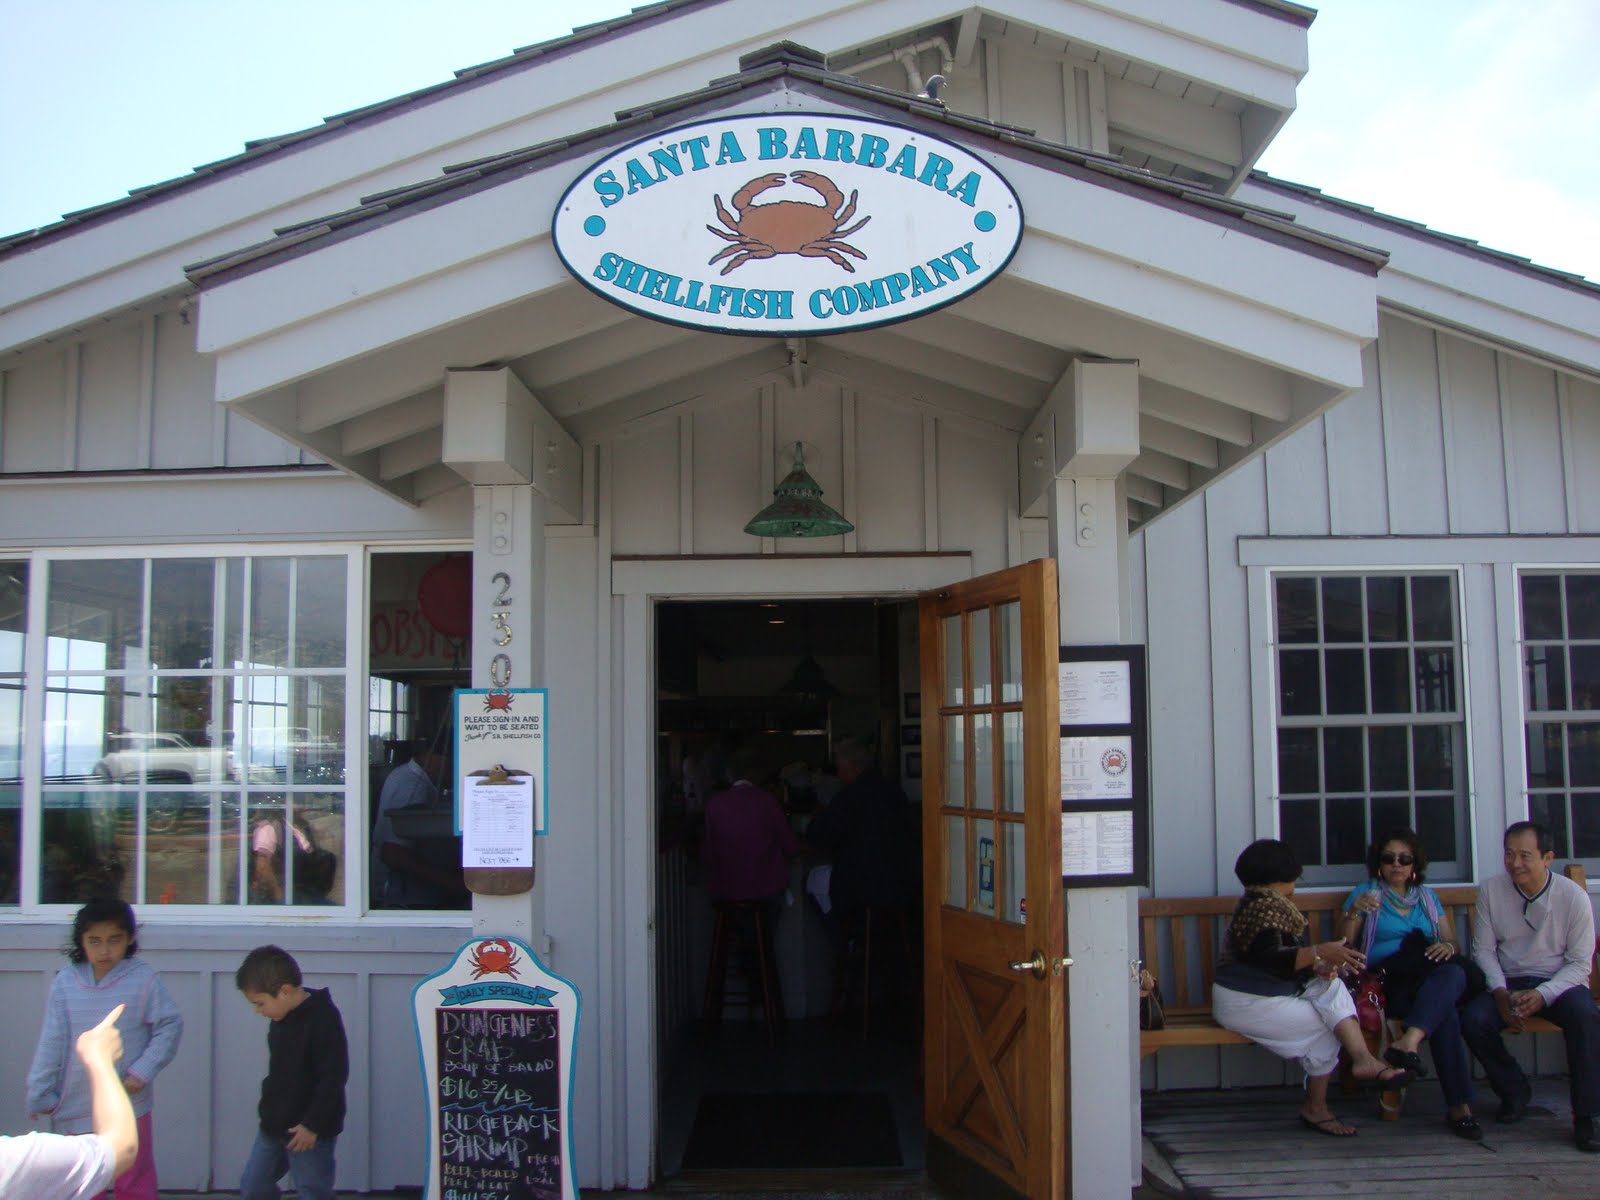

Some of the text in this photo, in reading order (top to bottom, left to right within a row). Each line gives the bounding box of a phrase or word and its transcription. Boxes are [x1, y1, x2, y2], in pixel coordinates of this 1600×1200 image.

[593, 127, 983, 208] SANTA BARBARA
[593, 243, 981, 320] SHELLFISH COMPANY
[490, 572, 512, 687] 230
[459, 986, 534, 1000] DAILY SPECIALS
[442, 1010, 557, 1042] DUNGENESS
[443, 1111, 560, 1138] RIDGEBACK
